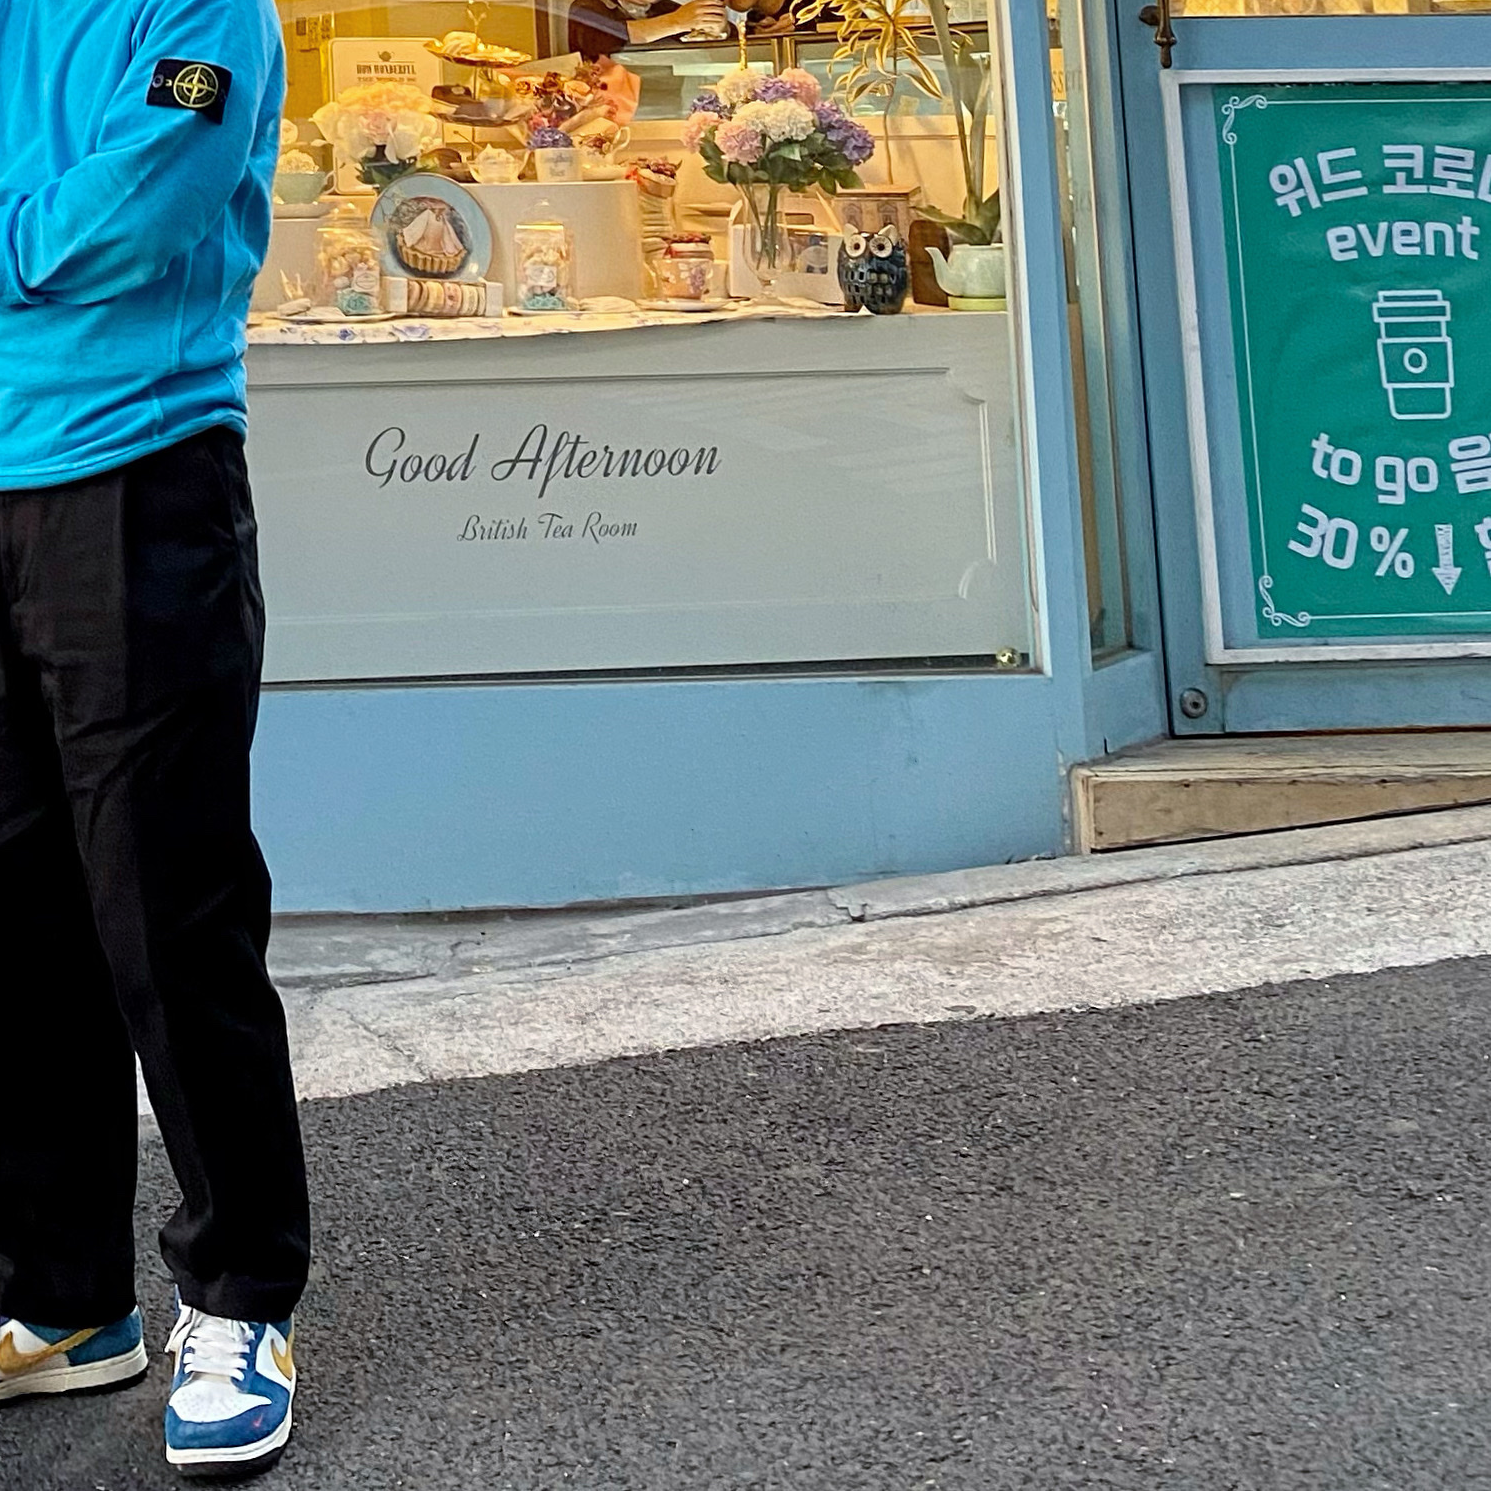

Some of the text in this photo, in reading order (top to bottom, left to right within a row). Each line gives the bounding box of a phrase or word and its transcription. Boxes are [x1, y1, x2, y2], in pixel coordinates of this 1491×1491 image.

[1269, 145, 1368, 217] 위드
[1326, 215, 1480, 261] event
[364, 423, 722, 499] Good Afternoon
[1311, 432, 1491, 505] to go 음
[456, 511, 639, 544] British Tea Room
[1287, 503, 1359, 569] 30
[1370, 525, 1415, 579] %
